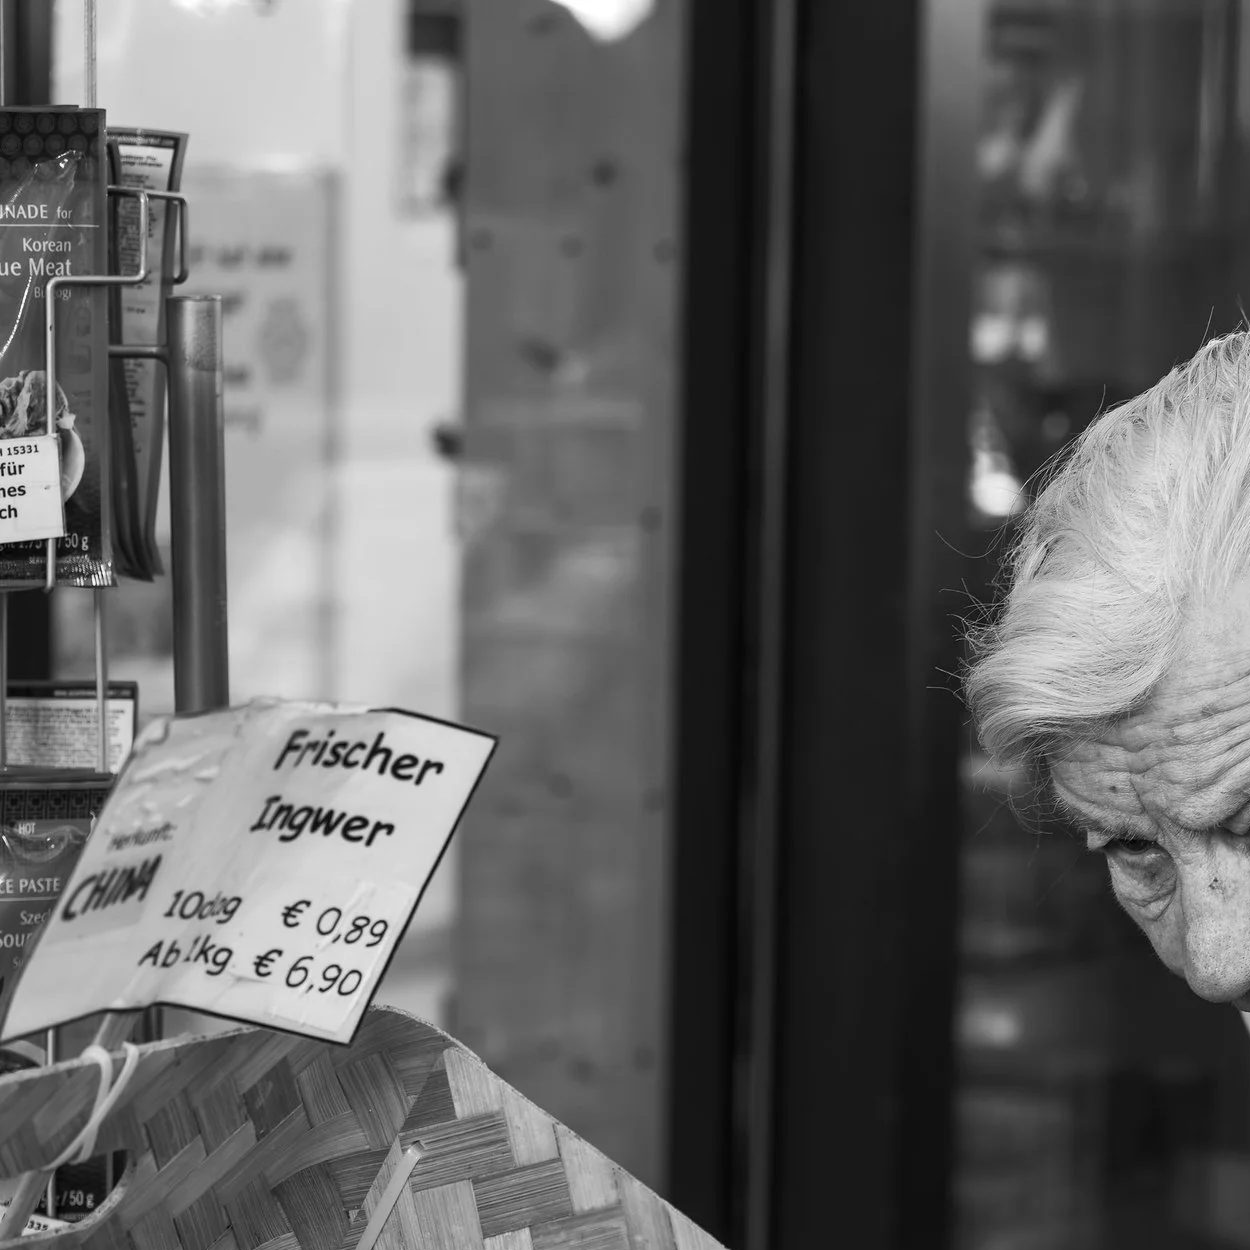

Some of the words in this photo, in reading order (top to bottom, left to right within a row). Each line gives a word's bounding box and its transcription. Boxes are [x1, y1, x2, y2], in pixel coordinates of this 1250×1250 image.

[56, 206, 72, 219] for
[22, 237, 71, 253] Korean
[29, 257, 71, 277] Meat
[7, 444, 39, 456] 15331
[0, 461, 25, 477] für
[81, 535, 89, 551] g
[273, 729, 445, 787] Frischer
[18, 822, 36, 835] HOT
[249, 794, 395, 848] Ingwer
[19, 878, 61, 894] PASTE
[61, 853, 163, 923] CHINA
[19, 909, 51, 926] Szec
[281, 899, 312, 929] €
[316, 906, 389, 949] 0,89
[137, 939, 182, 969] Ab
[252, 948, 284, 978] €
[285, 955, 363, 997] 6,90
[69, 1189, 84, 1206] 50
[86, 1192, 95, 1209] g
